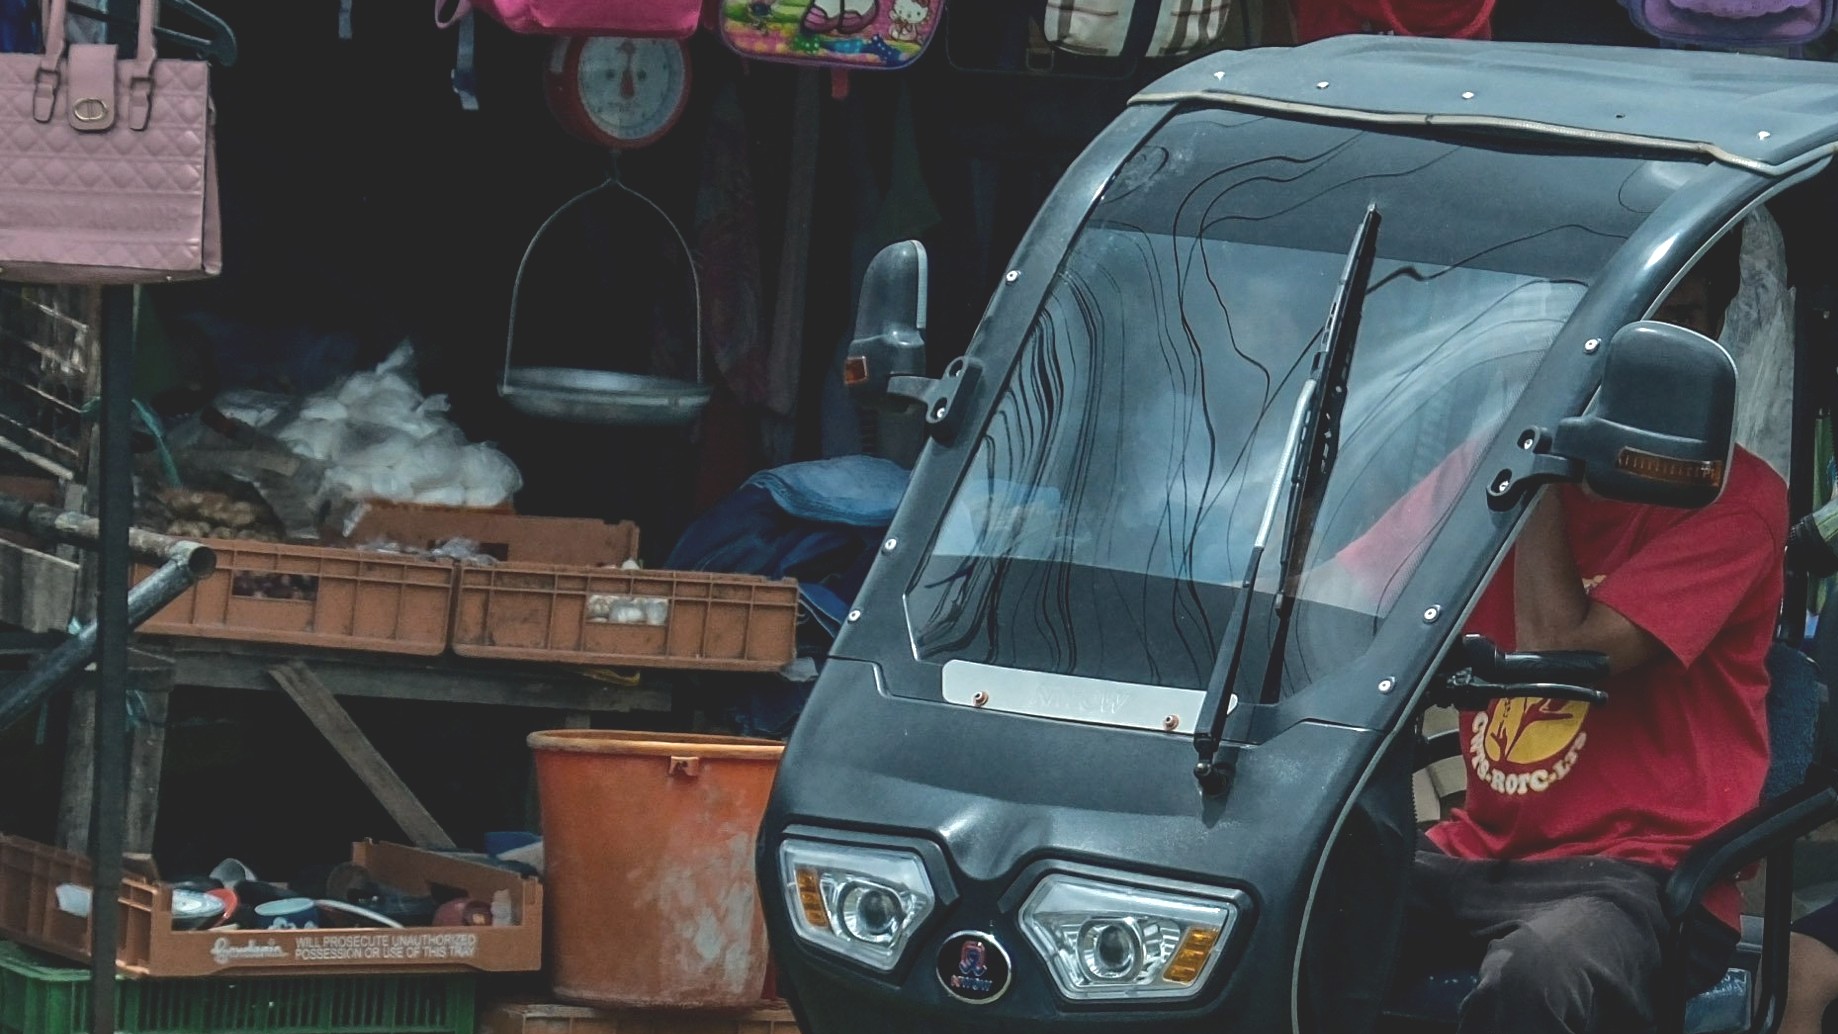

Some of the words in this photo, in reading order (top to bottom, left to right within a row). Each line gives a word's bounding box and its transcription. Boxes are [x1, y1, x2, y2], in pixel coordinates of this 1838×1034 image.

[296, 937, 320, 949] WILL
[322, 935, 389, 948] PROSECUTE
[392, 933, 477, 947] UNAUTHORIZED
[295, 947, 361, 961] POSSESSION
[364, 946, 380, 959] OR
[383, 946, 404, 959] USE
[406, 946, 420, 958] OF
[422, 945, 447, 958] THIS
